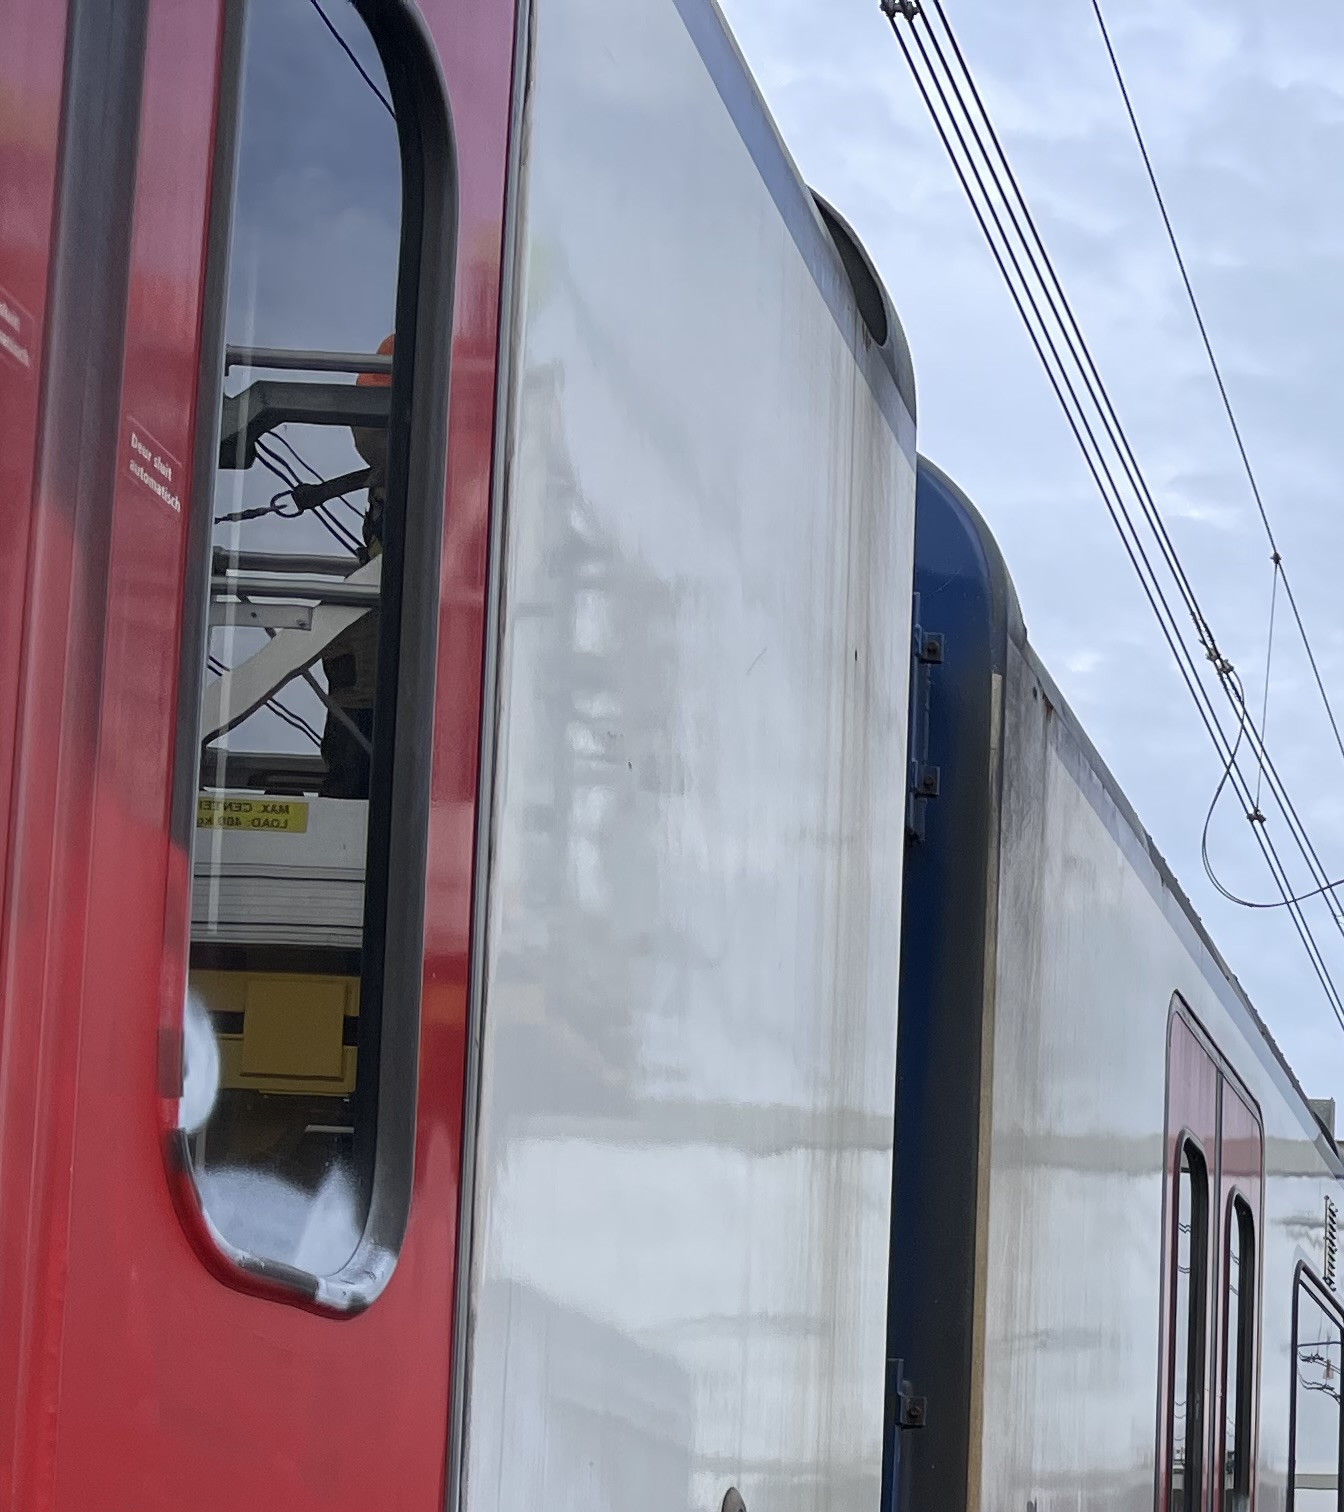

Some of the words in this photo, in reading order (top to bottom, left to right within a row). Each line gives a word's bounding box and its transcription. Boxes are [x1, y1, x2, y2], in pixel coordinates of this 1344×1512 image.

[130, 431, 152, 462] Deur
[153, 456, 172, 482] sluit
[129, 459, 181, 513] automatisch
